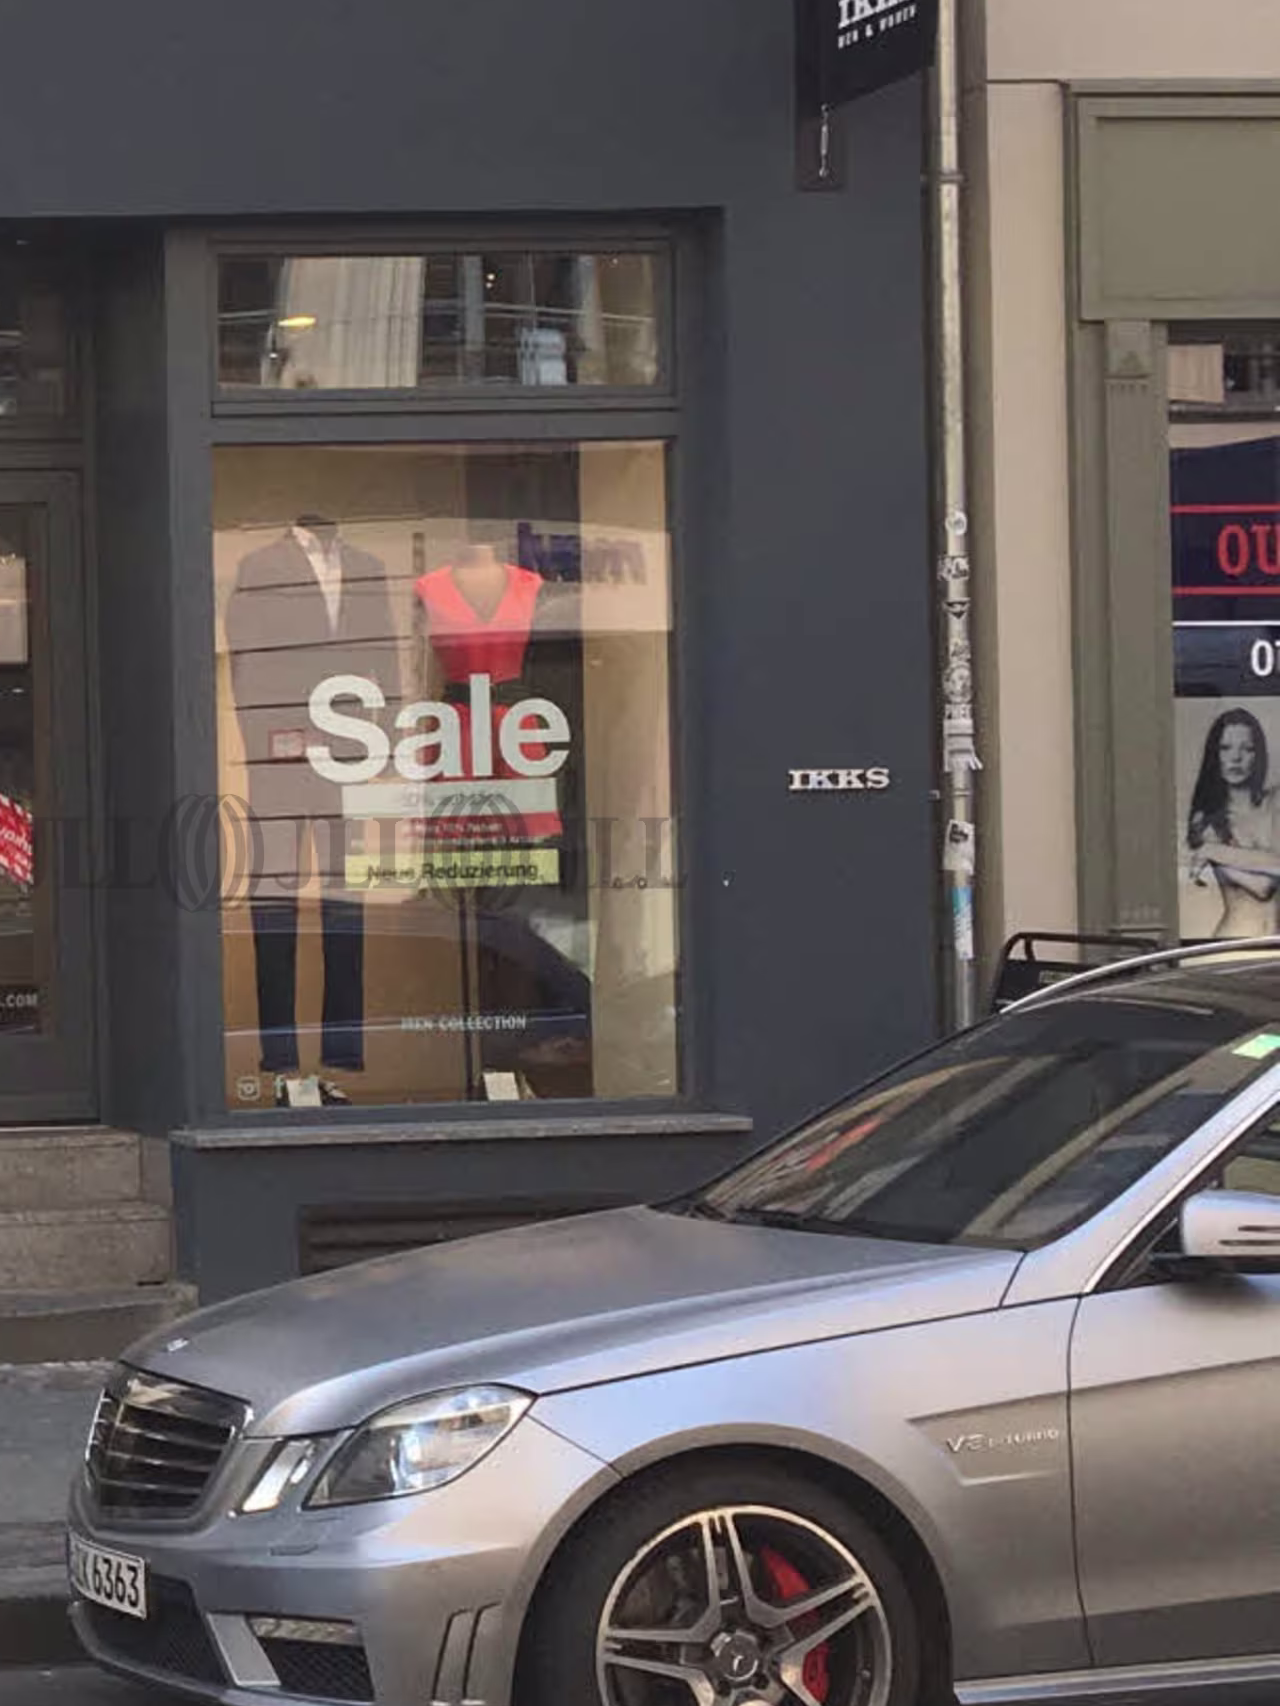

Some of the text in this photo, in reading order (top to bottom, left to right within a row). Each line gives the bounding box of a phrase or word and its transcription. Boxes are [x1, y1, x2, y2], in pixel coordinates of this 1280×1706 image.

[306, 673, 571, 784] Sale
[788, 766, 890, 790] IKKS
[368, 862, 538, 882] Neue Reduzierung
[438, 1015, 527, 1031] COLLECTION
[94, 1551, 140, 1608] 6363
